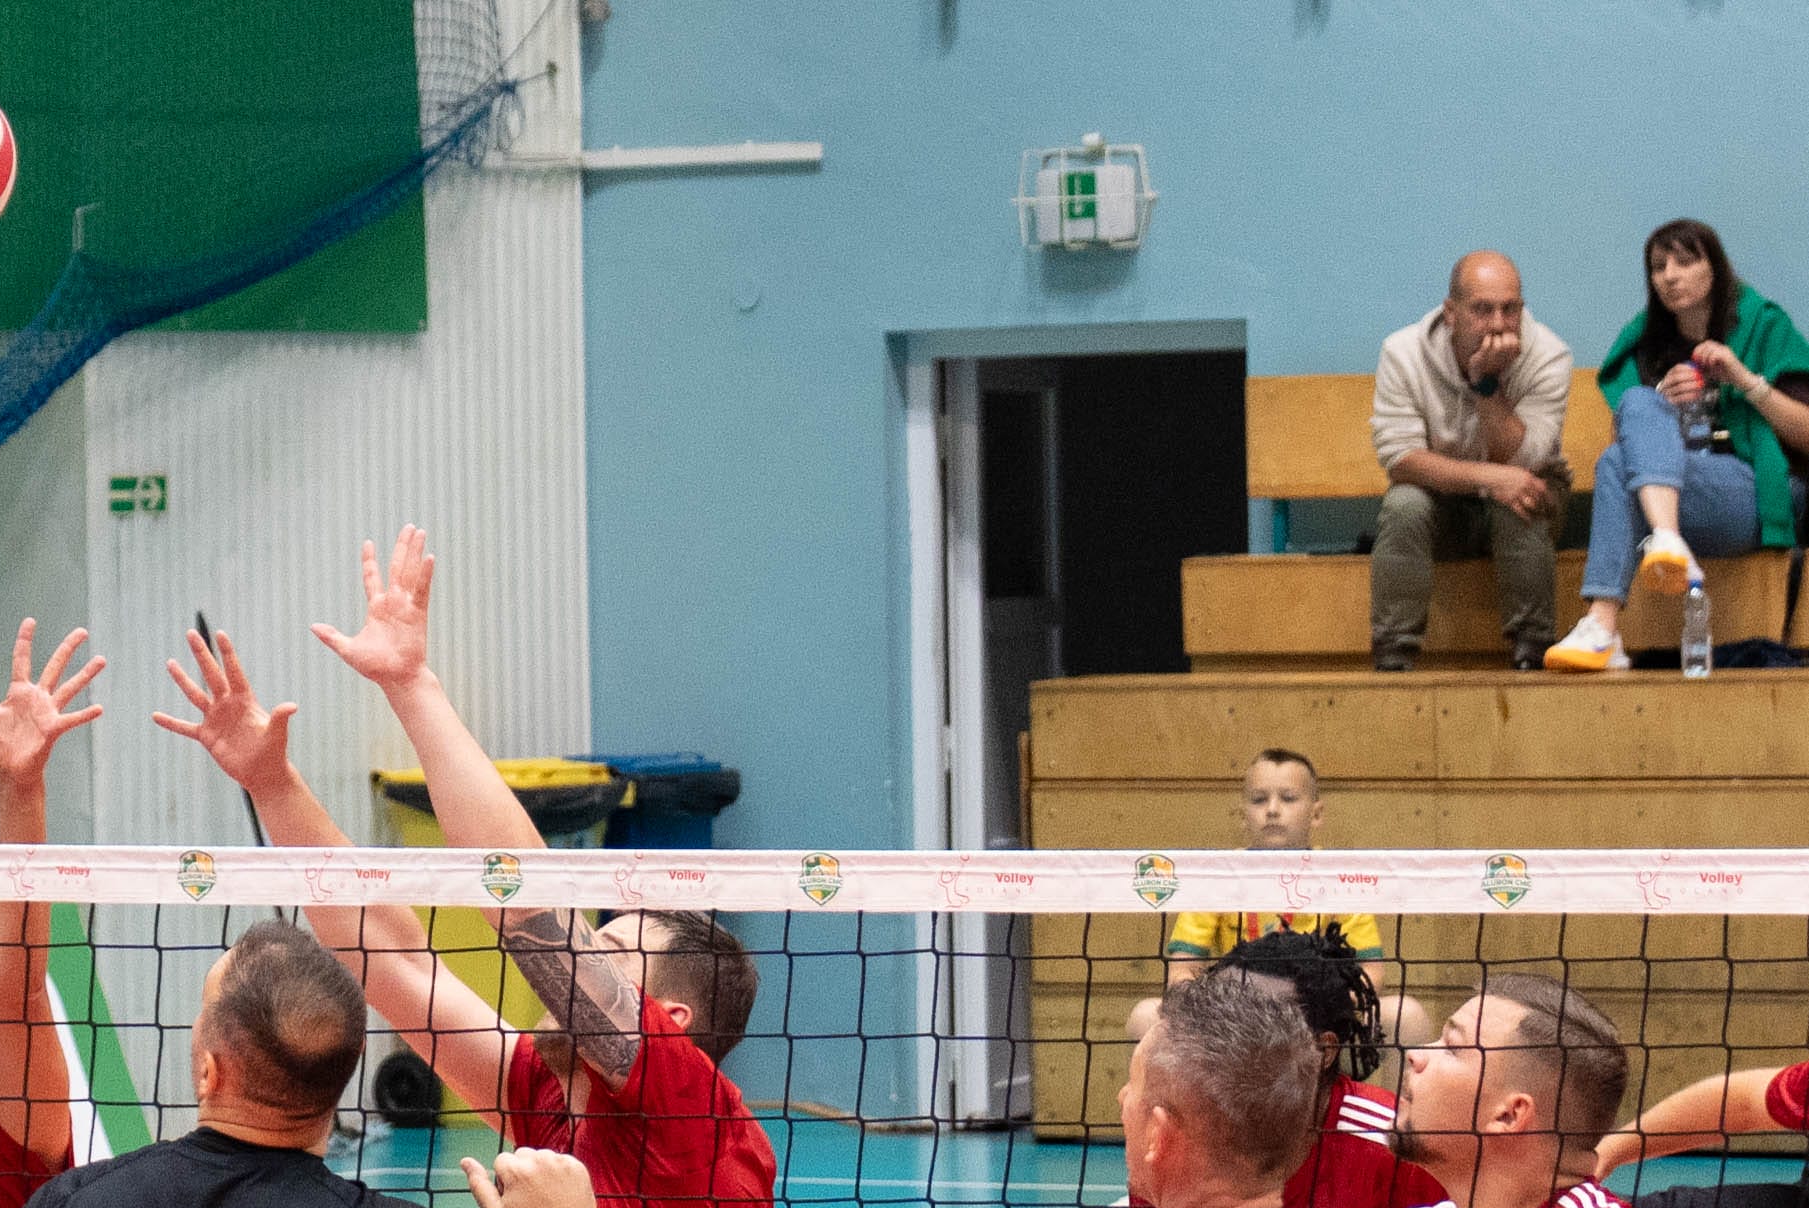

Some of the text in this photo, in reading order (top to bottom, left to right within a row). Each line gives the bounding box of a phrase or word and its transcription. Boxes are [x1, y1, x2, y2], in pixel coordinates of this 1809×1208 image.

[55, 865, 92, 878] Volley
[352, 868, 392, 882] Volley
[666, 869, 707, 883] Volley
[992, 872, 1036, 887] Volley
[1337, 873, 1380, 887] Volley
[1698, 871, 1743, 887] Volley
